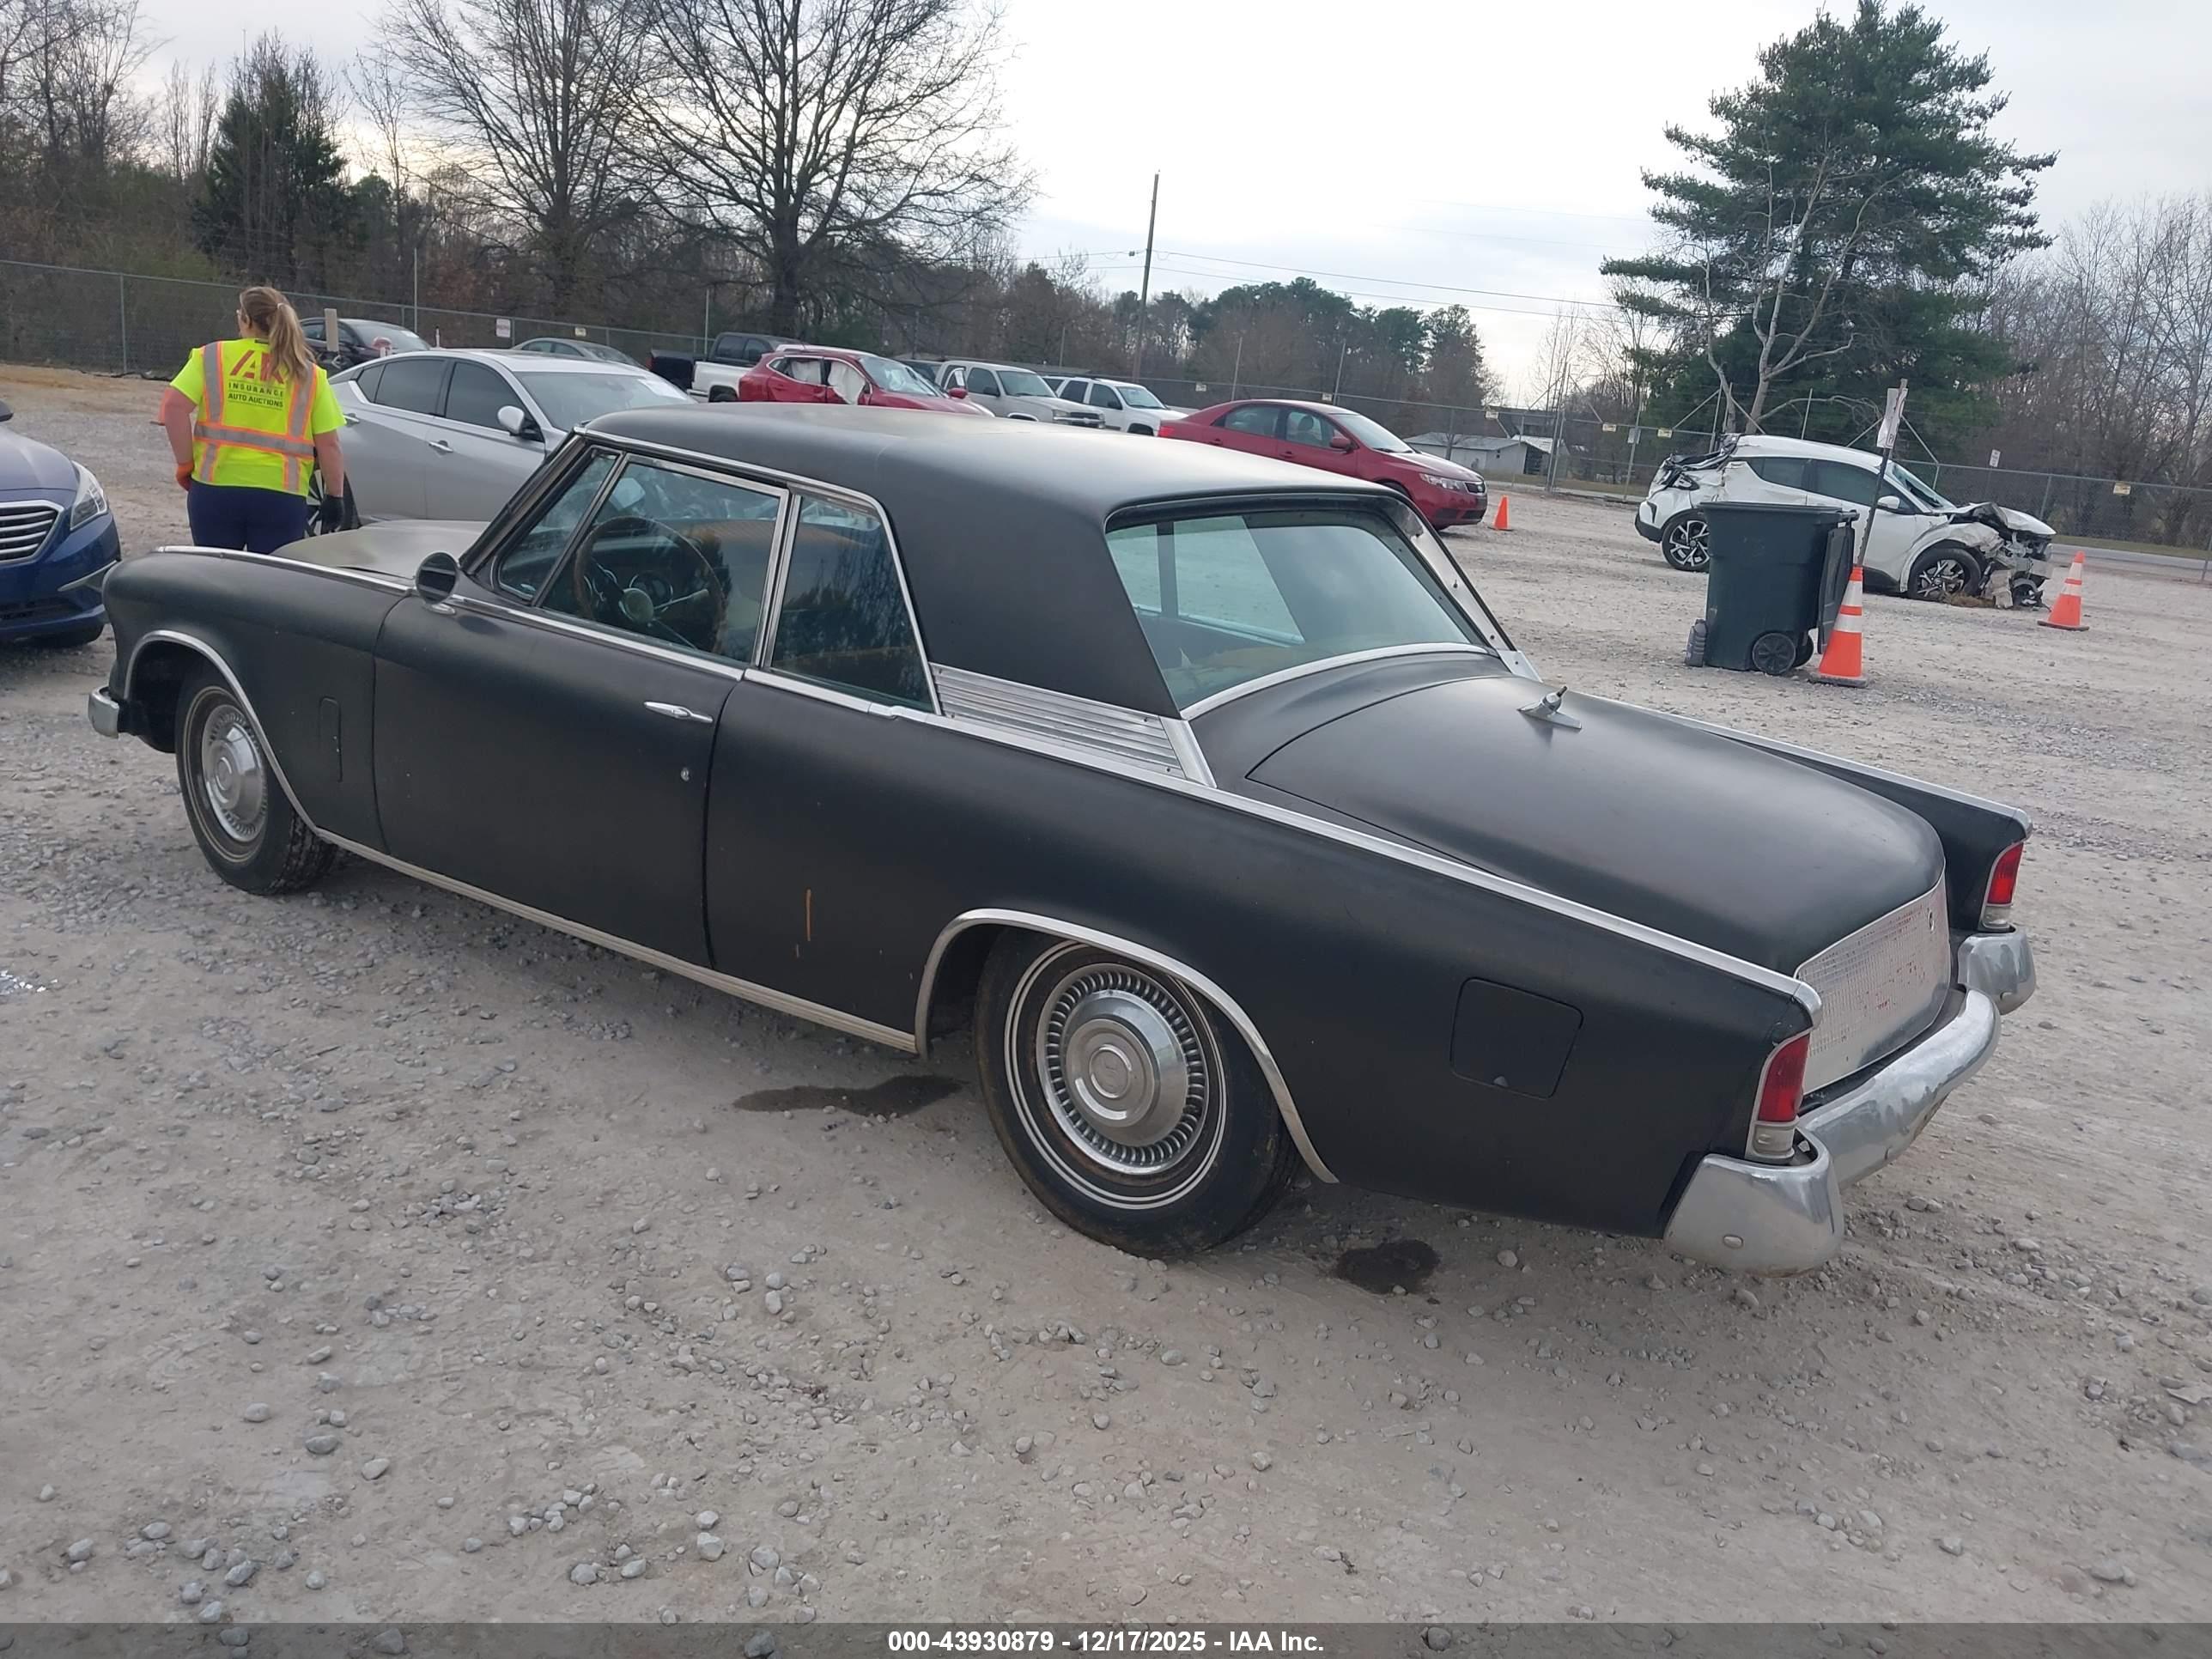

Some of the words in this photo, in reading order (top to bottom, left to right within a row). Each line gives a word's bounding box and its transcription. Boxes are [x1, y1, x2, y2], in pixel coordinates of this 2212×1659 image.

[228, 382, 283, 398] INSURANCE
[228, 392, 247, 402] AUTO
[248, 396, 283, 408] AUCTIONS
